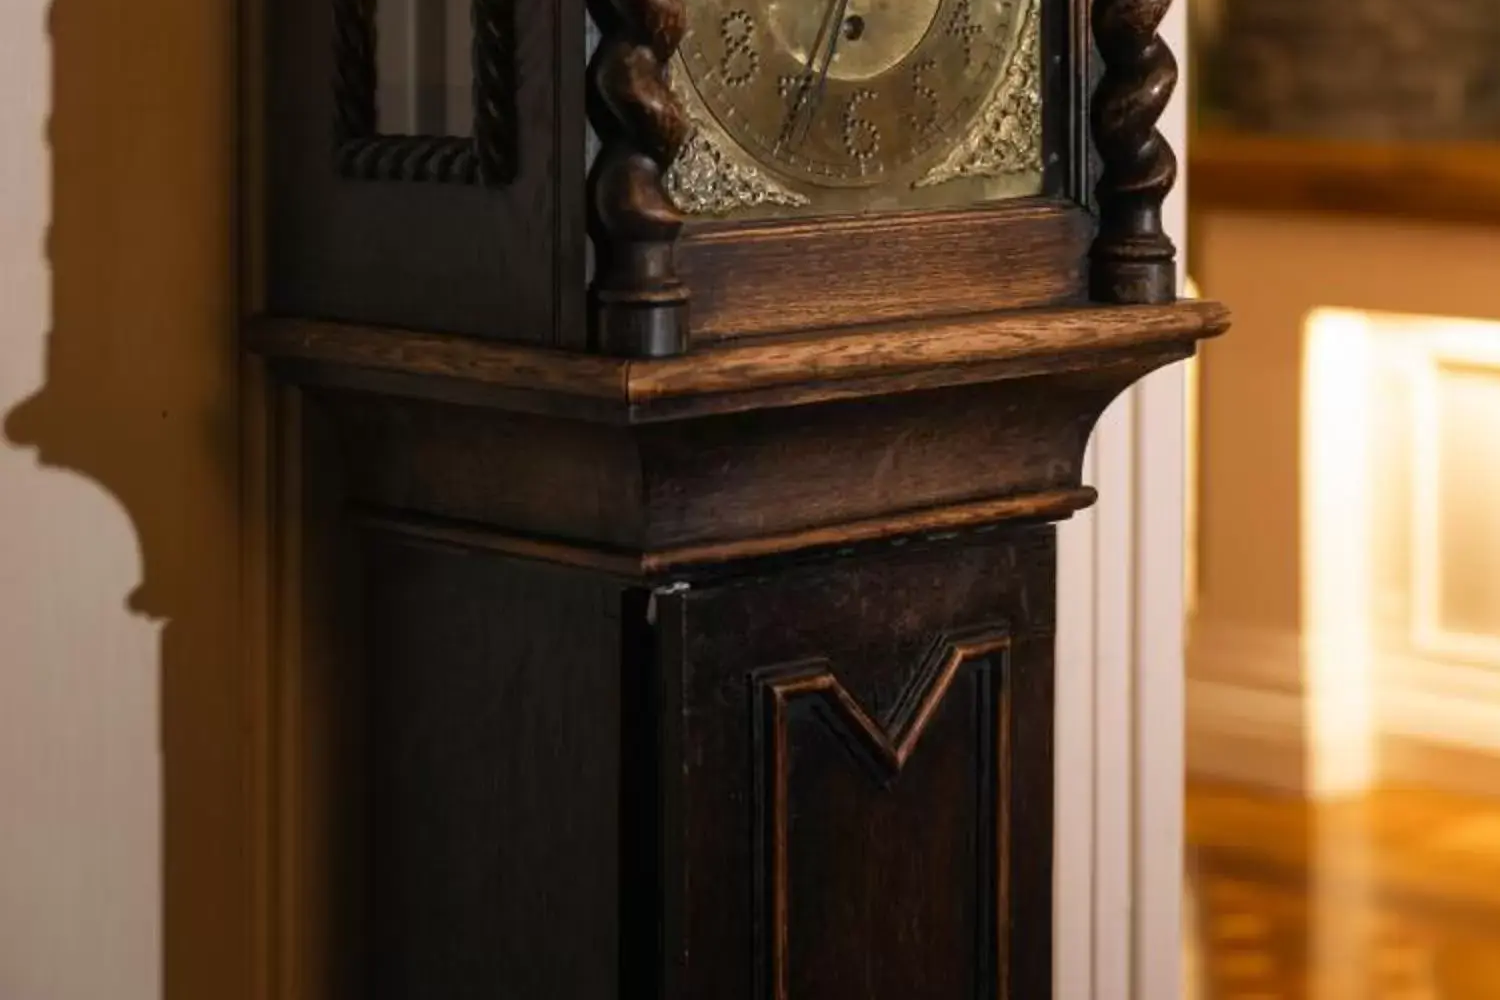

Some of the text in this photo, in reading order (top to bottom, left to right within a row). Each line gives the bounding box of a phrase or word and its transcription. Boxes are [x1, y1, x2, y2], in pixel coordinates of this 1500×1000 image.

[720, 8, 759, 87] 8
[843, 88, 881, 160] 6
[907, 59, 938, 133] 5
